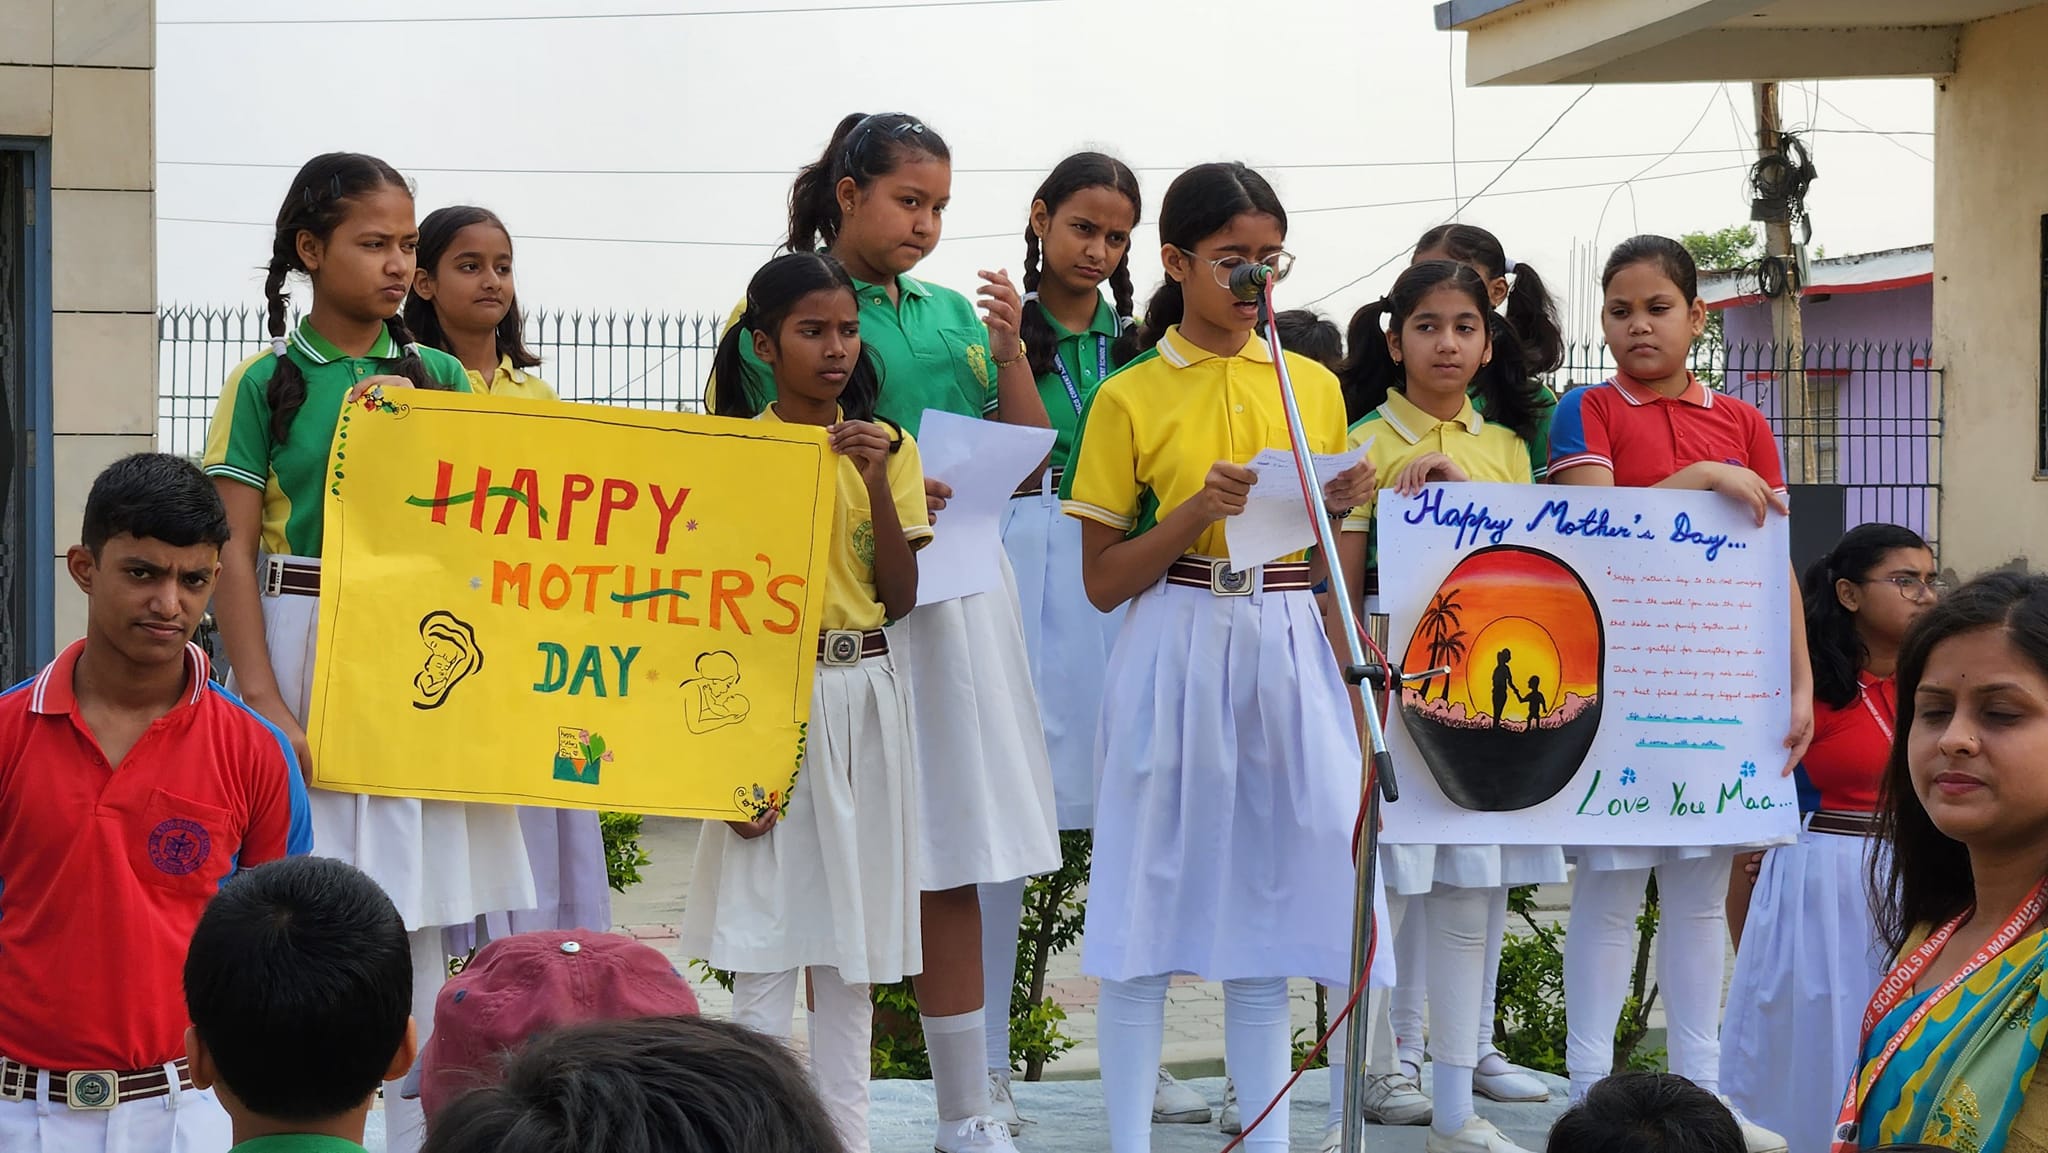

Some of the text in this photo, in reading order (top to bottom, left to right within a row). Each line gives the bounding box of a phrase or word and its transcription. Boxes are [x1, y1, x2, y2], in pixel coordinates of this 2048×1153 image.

[406, 460, 691, 554] HAPPY
[1404, 487, 1747, 562] Happy Mother's Day...
[491, 553, 806, 635] MOTHER'S
[532, 641, 641, 698] DAY
[1576, 770, 1793, 817] Love You Maa...
[1863, 1010, 1874, 1031] OF
[1872, 954, 1924, 1013] SCHOOLS
[1877, 1024, 1910, 1070] GROUP
[1911, 1005, 1928, 1023] OF
[1929, 952, 1989, 1005] SCHOOLS
